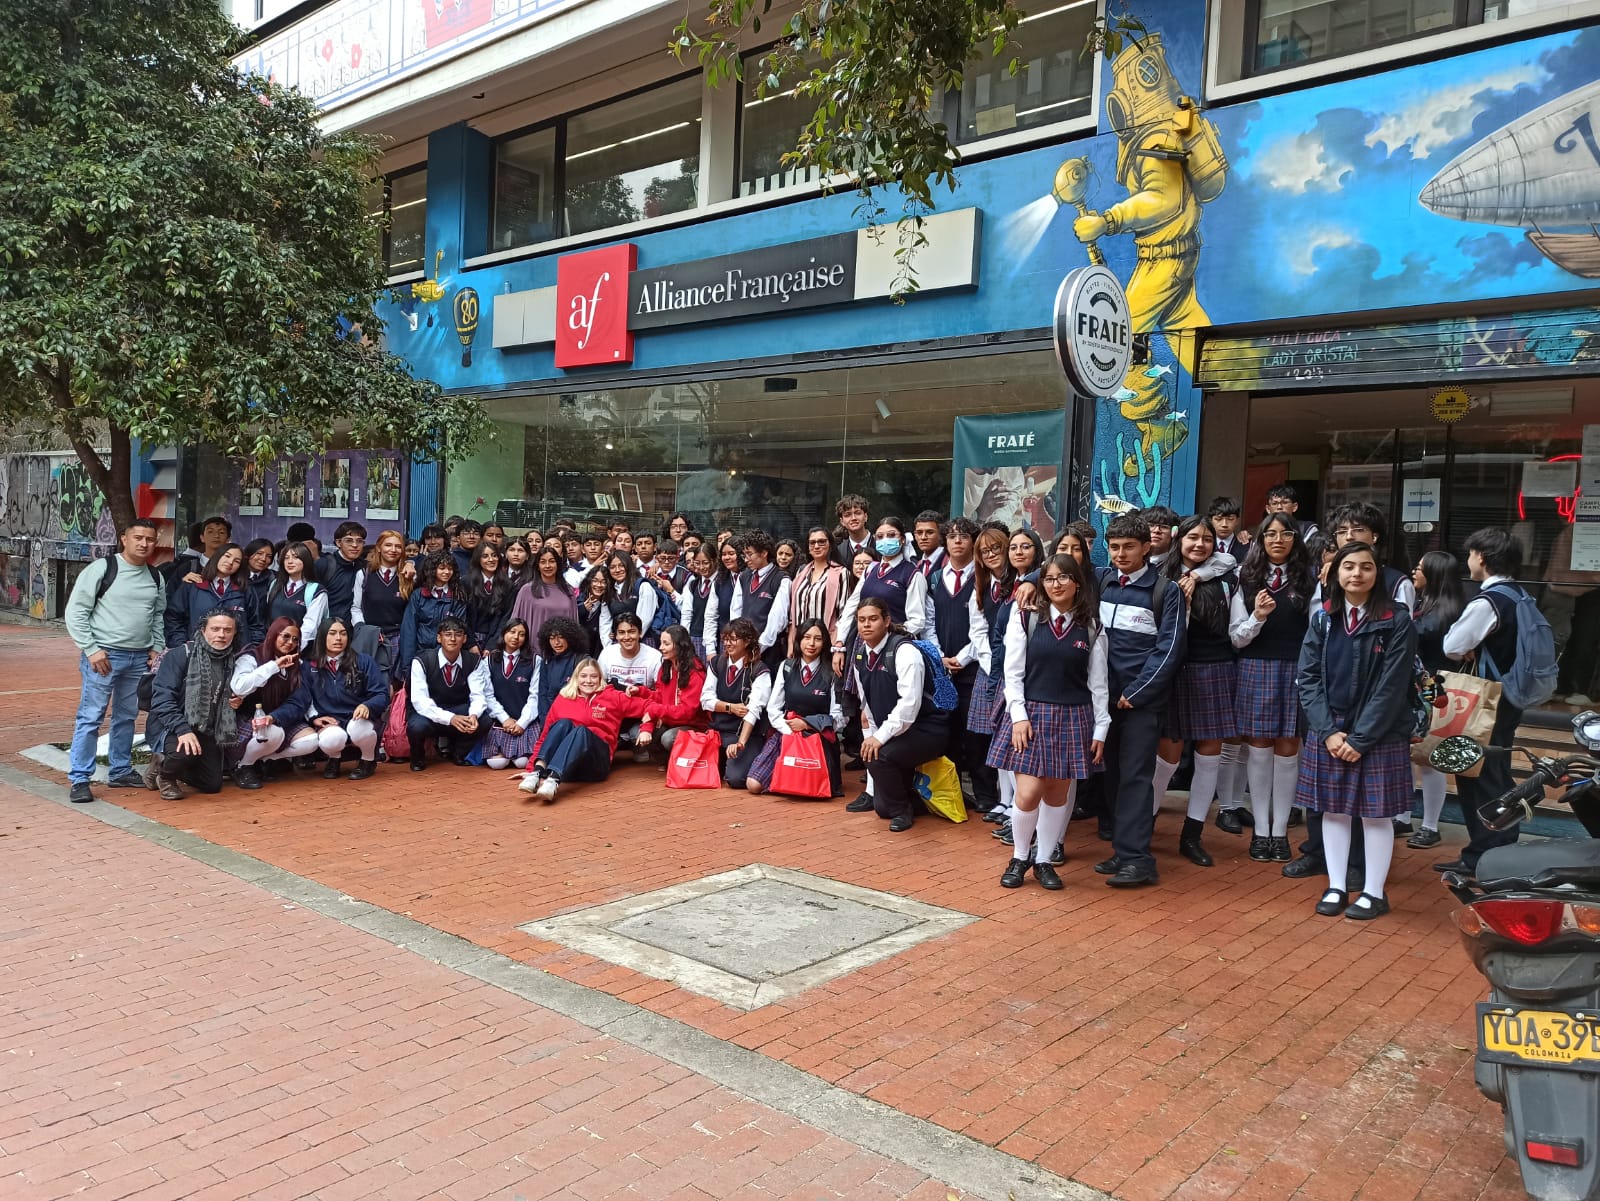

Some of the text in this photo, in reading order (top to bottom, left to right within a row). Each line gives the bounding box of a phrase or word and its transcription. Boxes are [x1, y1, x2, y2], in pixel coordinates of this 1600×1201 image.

[635, 257, 844, 314] AllianceFrançaise
[461, 298, 477, 325] 80
[568, 272, 610, 350] af
[1078, 312, 1127, 346] FRATÉ
[988, 432, 1034, 448] FRATÉ
[1488, 1015, 1541, 1048] YOA
[1524, 1048, 1571, 1059] COLOMBIA
